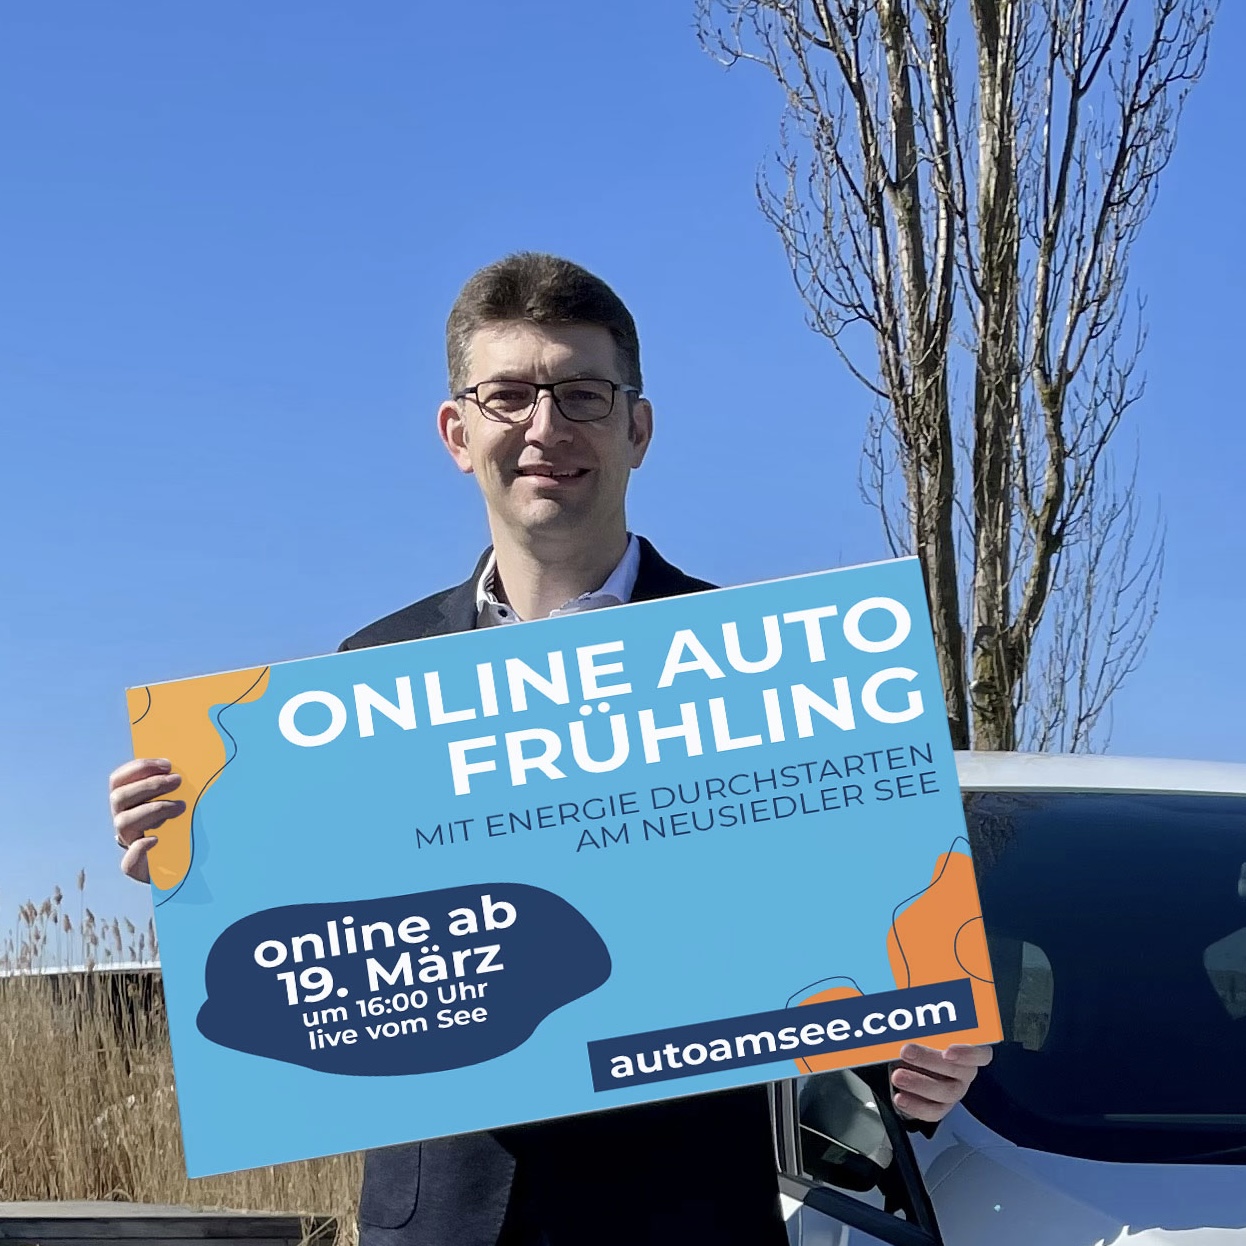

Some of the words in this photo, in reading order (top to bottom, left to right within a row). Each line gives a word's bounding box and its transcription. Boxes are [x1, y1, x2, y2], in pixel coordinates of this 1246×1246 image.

[279, 641, 633, 747] ONLINE
[657, 597, 912, 689] AUTO
[448, 668, 924, 796] FRÜHLING
[416, 818, 475, 850] MIT
[486, 792, 640, 838] ENERGIE
[650, 743, 933, 810] DURCHSTARTEN
[575, 822, 630, 853] AM
[642, 785, 865, 841] NEUSIEDLER
[874, 770, 940, 802] SEE
[253, 915, 431, 968] online
[448, 894, 517, 937] ab
[276, 966, 349, 1006] 19.
[366, 944, 504, 992] März
[302, 1006, 348, 1028] um
[356, 989, 428, 1018] 16:00
[438, 981, 488, 1005] Uhr
[308, 1028, 358, 1050] live
[366, 1017, 428, 1040] vom
[436, 1007, 488, 1029] See
[610, 1000, 957, 1079] autoamsee.com
